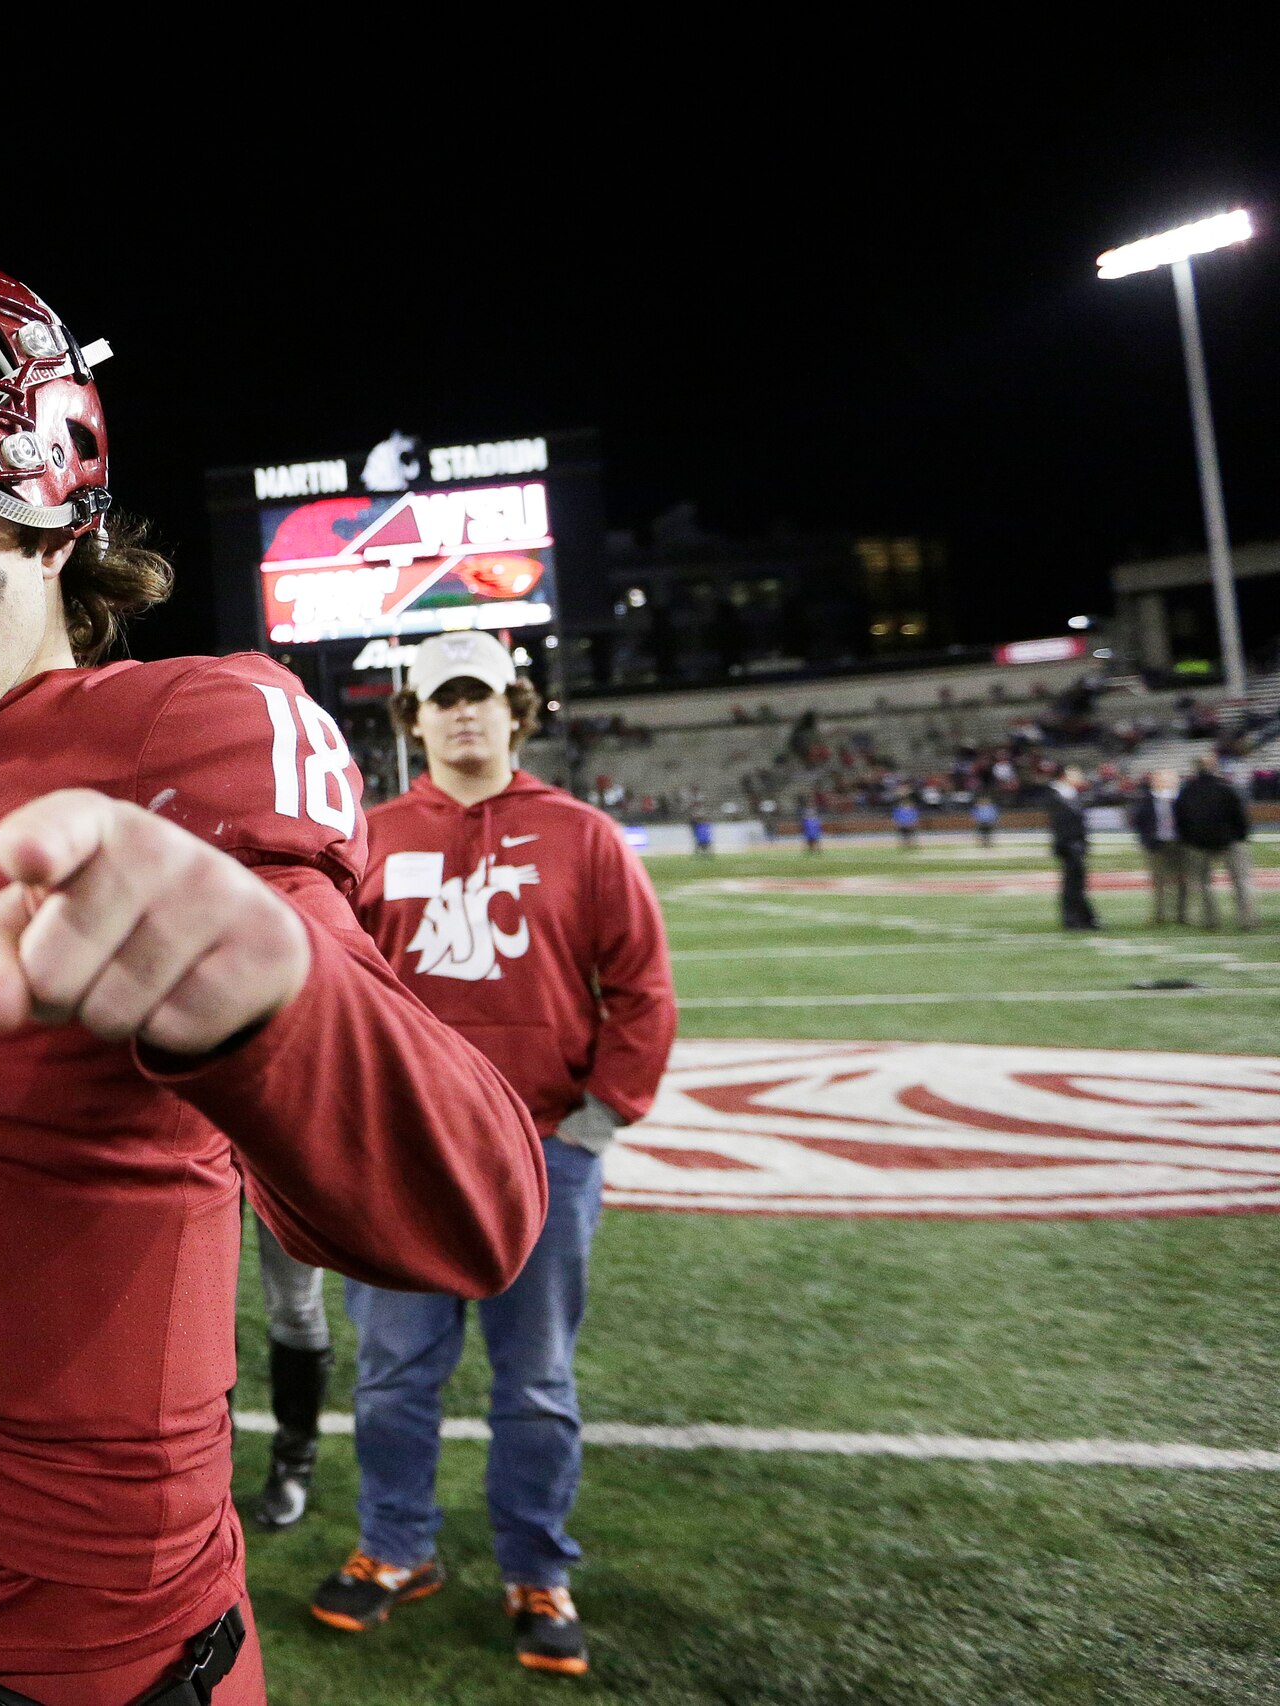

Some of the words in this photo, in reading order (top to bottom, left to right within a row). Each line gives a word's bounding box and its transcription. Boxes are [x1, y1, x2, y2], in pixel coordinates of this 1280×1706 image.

[256, 460, 347, 498] MARTIN
[430, 440, 547, 481] STADIUM
[407, 483, 548, 550] WSU
[251, 682, 356, 839] 18
